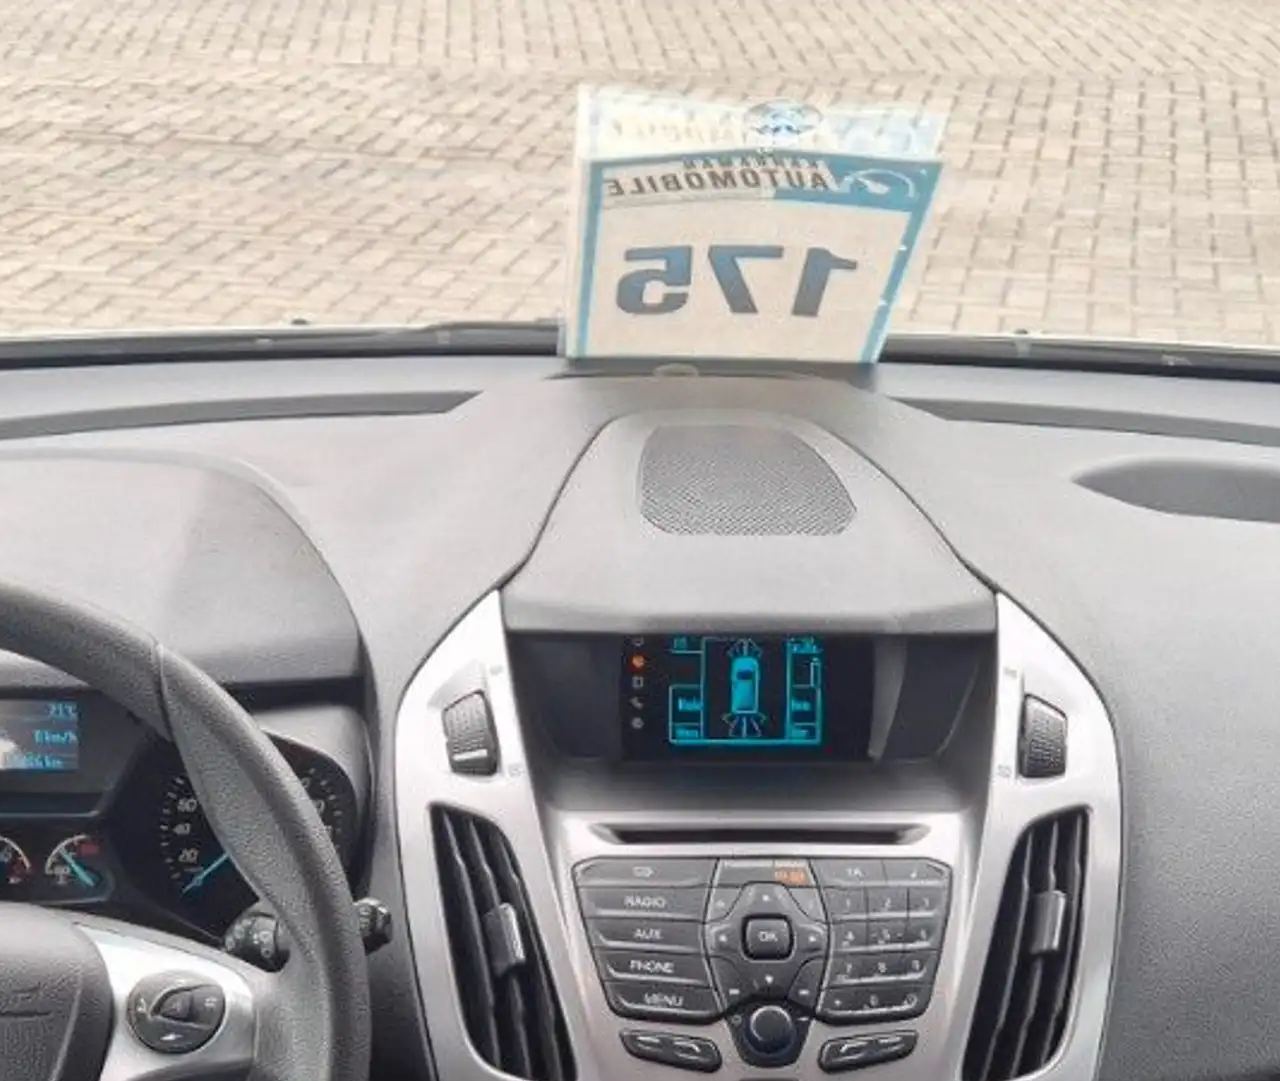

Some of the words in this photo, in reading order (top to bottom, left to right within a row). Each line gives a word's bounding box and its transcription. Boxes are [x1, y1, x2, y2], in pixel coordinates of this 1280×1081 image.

[624, 895, 667, 908] RADIO
[633, 928, 663, 940] AUX
[629, 959, 674, 974] PHONE
[643, 992, 684, 1007] MENU
